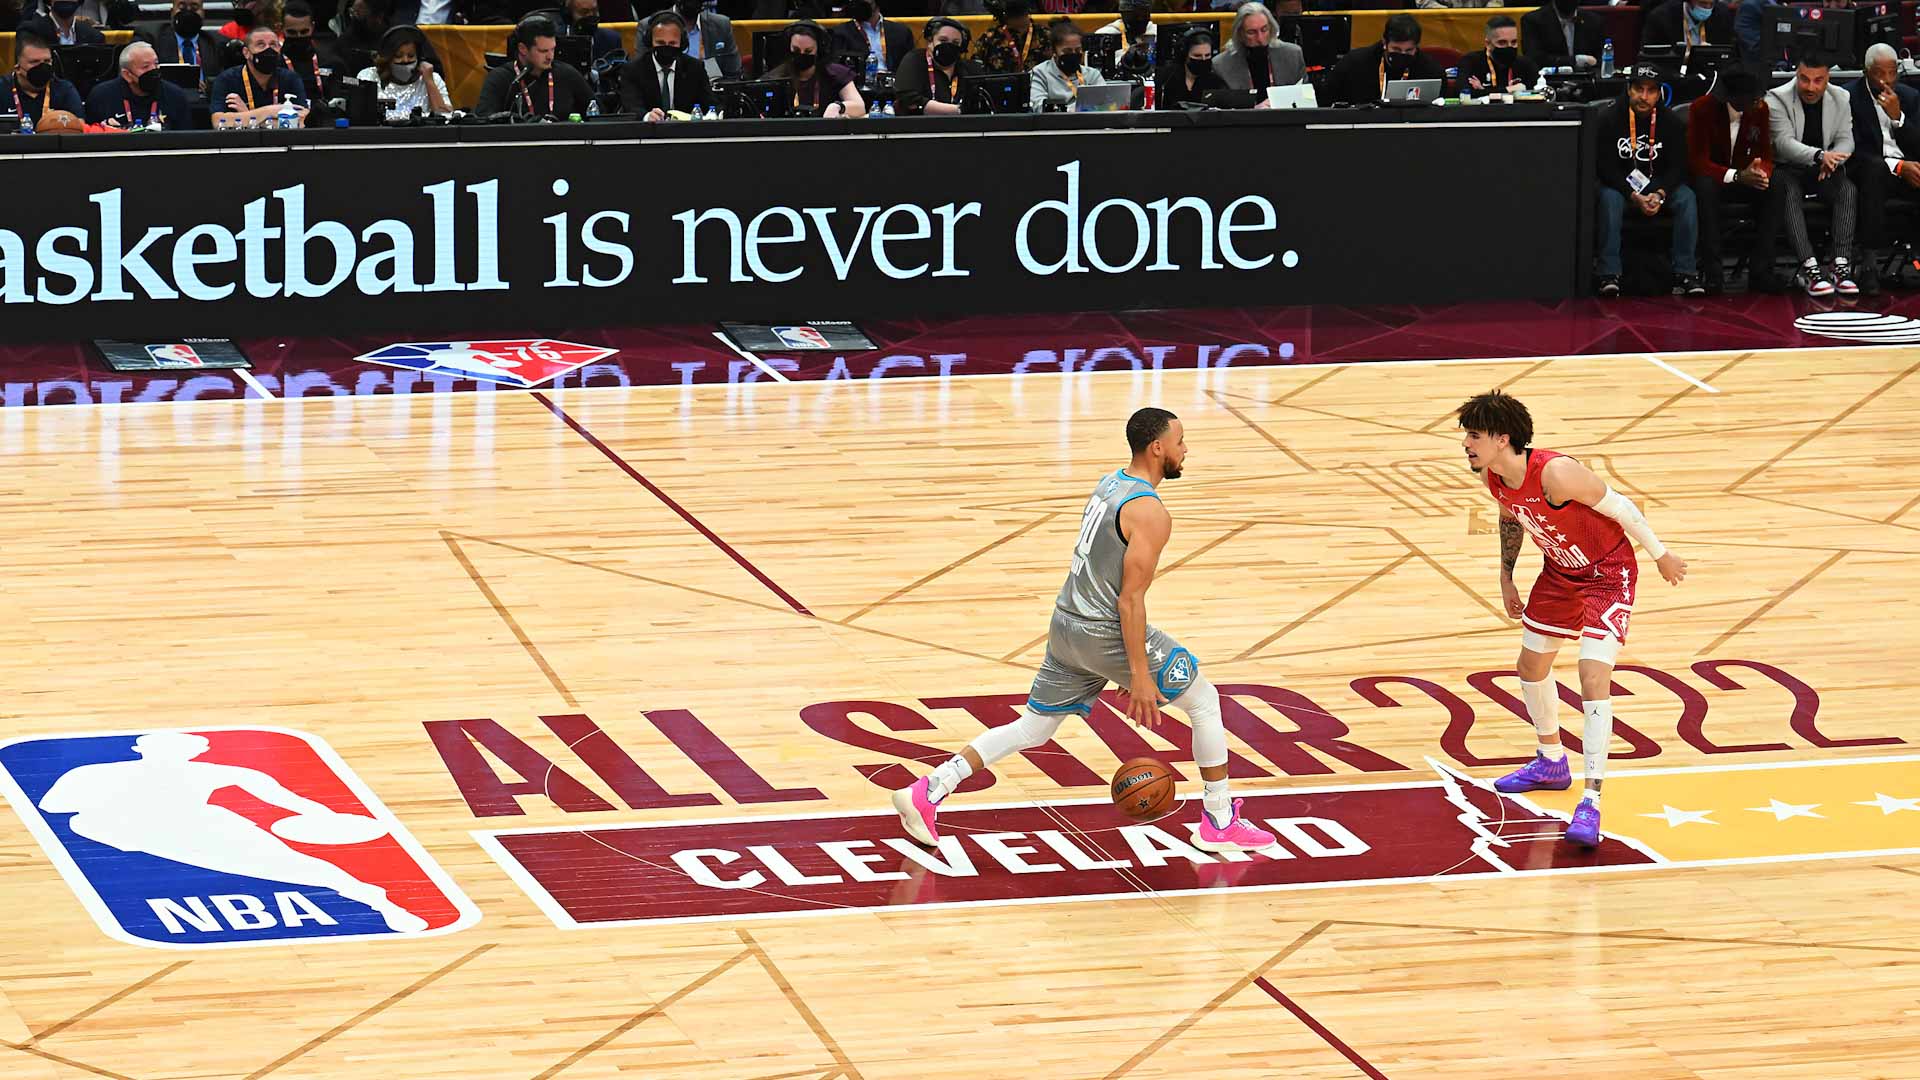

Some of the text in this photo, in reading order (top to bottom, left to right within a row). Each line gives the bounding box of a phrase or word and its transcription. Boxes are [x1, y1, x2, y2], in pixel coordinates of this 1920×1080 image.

[0, 160, 1299, 305] asketball is never done.
[504, 346, 563, 361] 75
[423, 658, 1906, 818] ALL STAR 2022
[1115, 771, 1153, 795] Wilson
[147, 890, 338, 934] NBA
